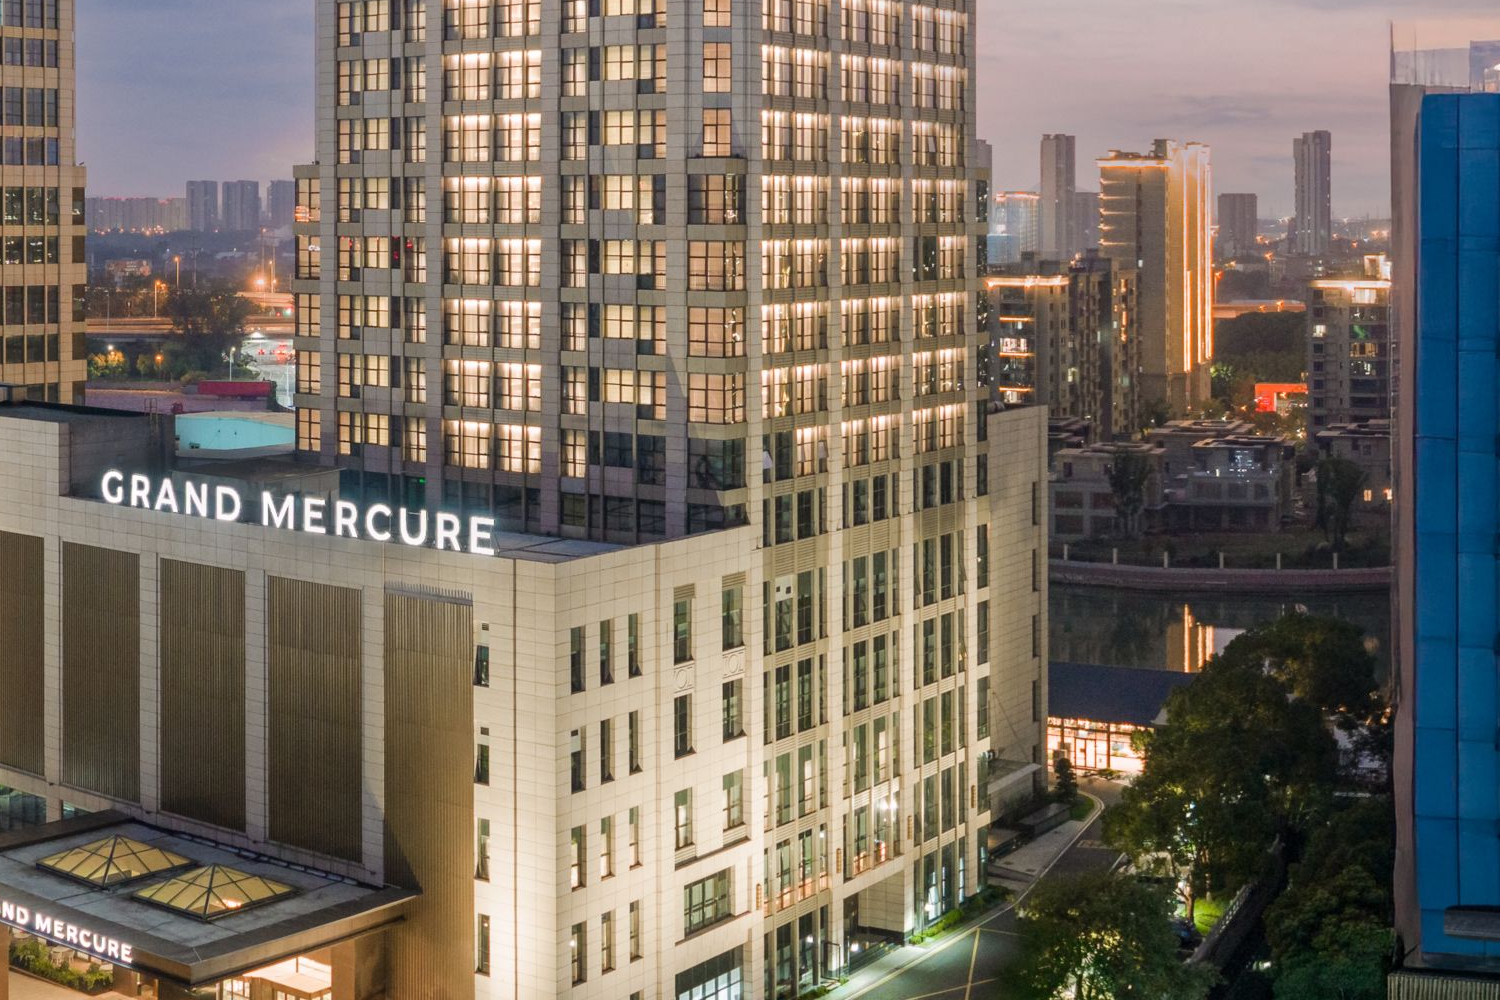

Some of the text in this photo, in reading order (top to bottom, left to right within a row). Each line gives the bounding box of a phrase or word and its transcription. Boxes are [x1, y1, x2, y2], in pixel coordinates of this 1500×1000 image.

[101, 469, 495, 555] GRAND MERCURE
[35, 913, 133, 963] MERCURE
